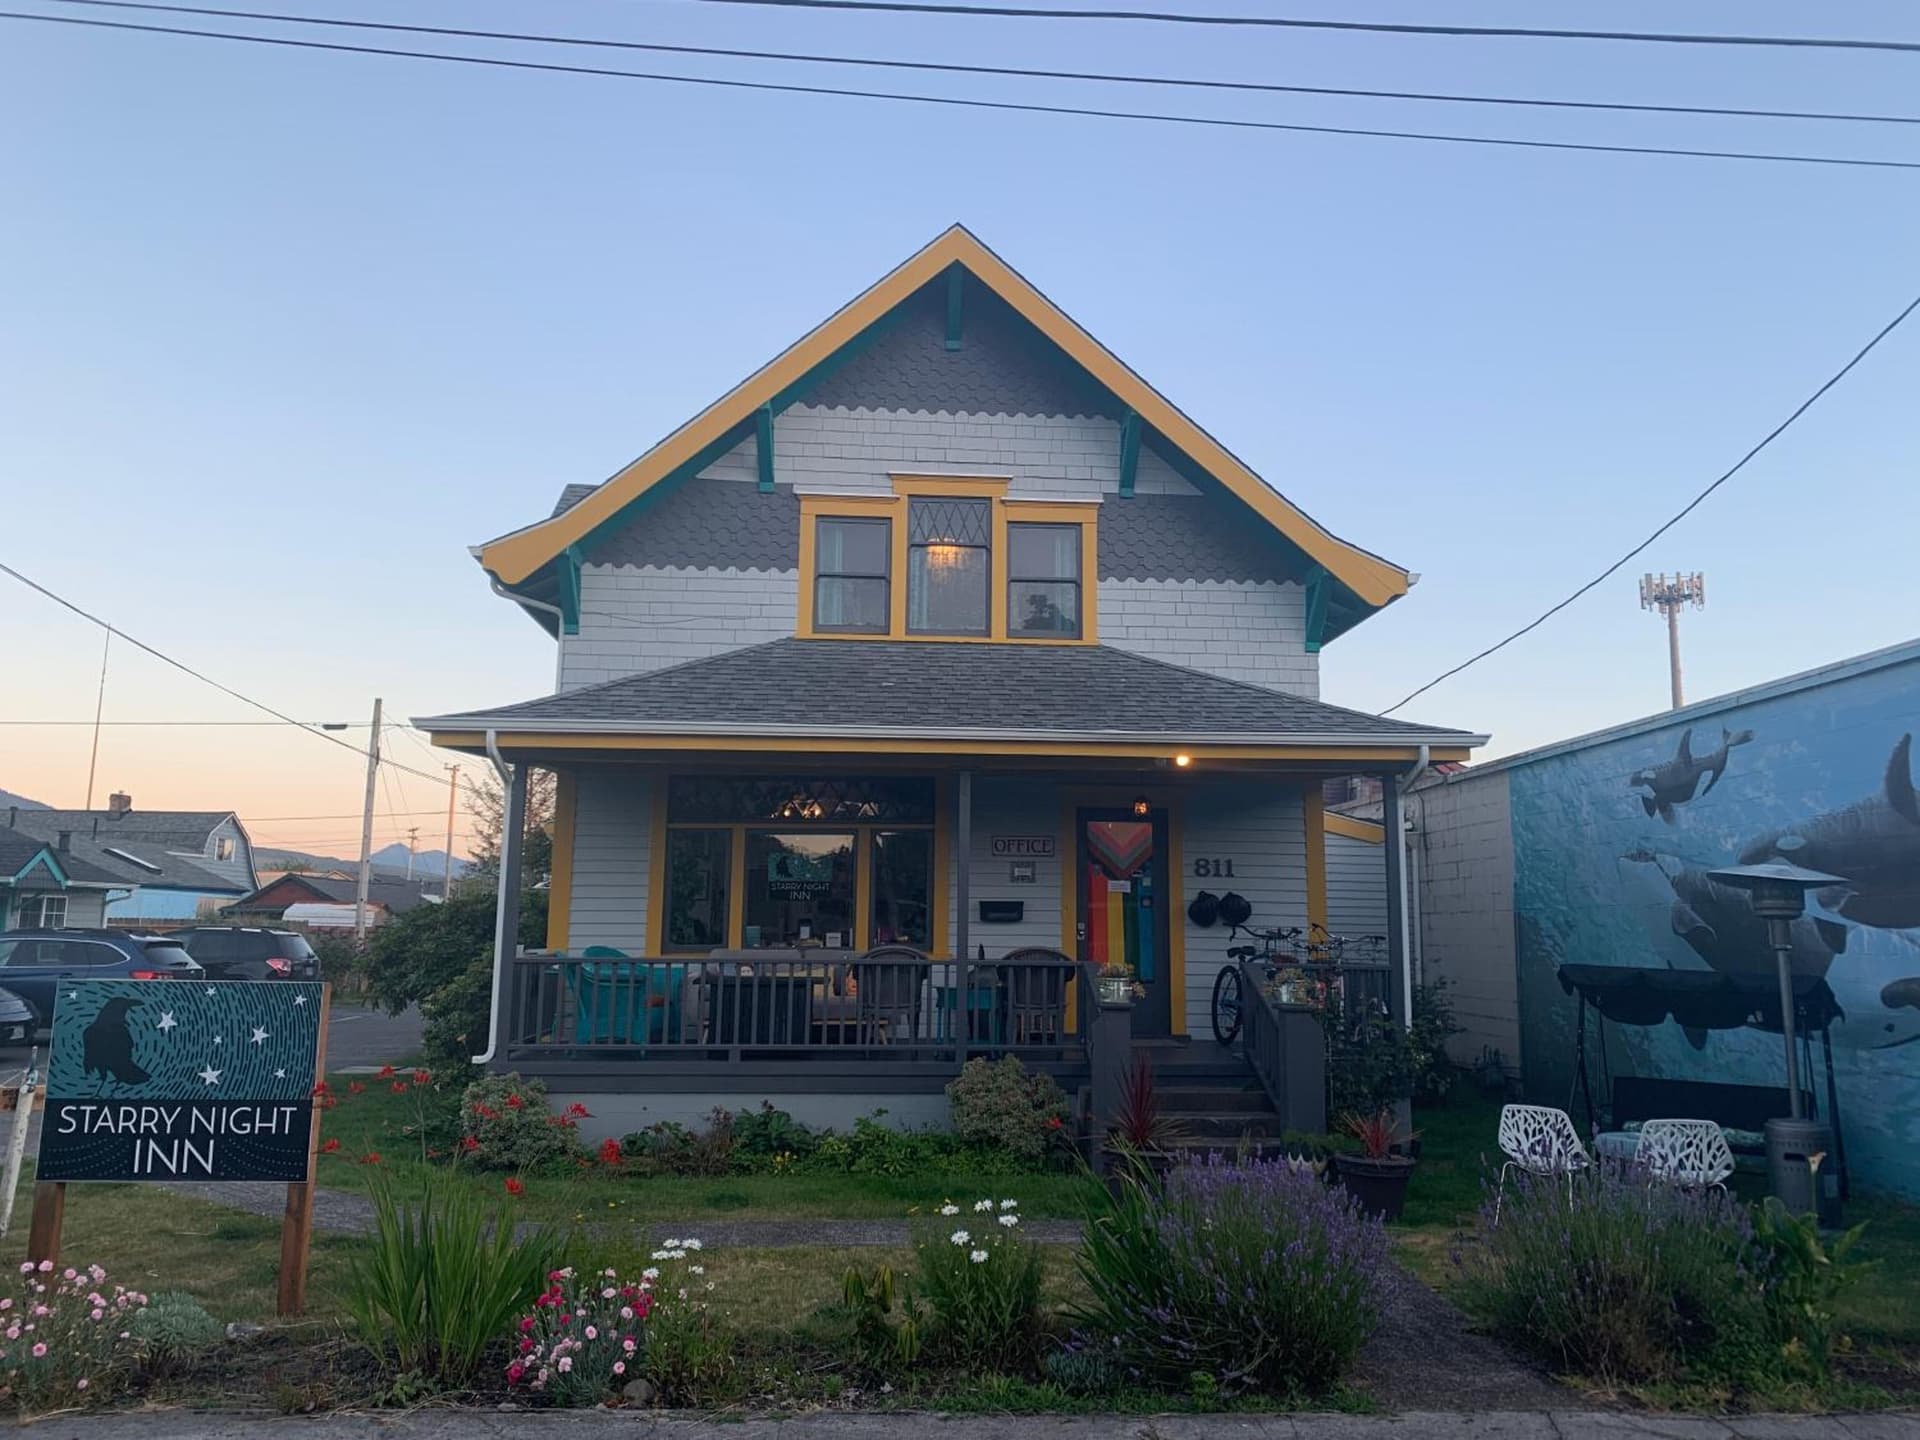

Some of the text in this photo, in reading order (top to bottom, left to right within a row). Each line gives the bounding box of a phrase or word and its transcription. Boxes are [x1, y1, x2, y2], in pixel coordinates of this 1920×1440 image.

[994, 839, 1051, 853] OFFICE
[1194, 858, 1234, 877] 811
[770, 882, 831, 891] STARRY NIGHT
[789, 891, 811, 900] INN
[57, 1105, 298, 1136] STARRY NIGHT
[133, 1138, 215, 1175] INN
